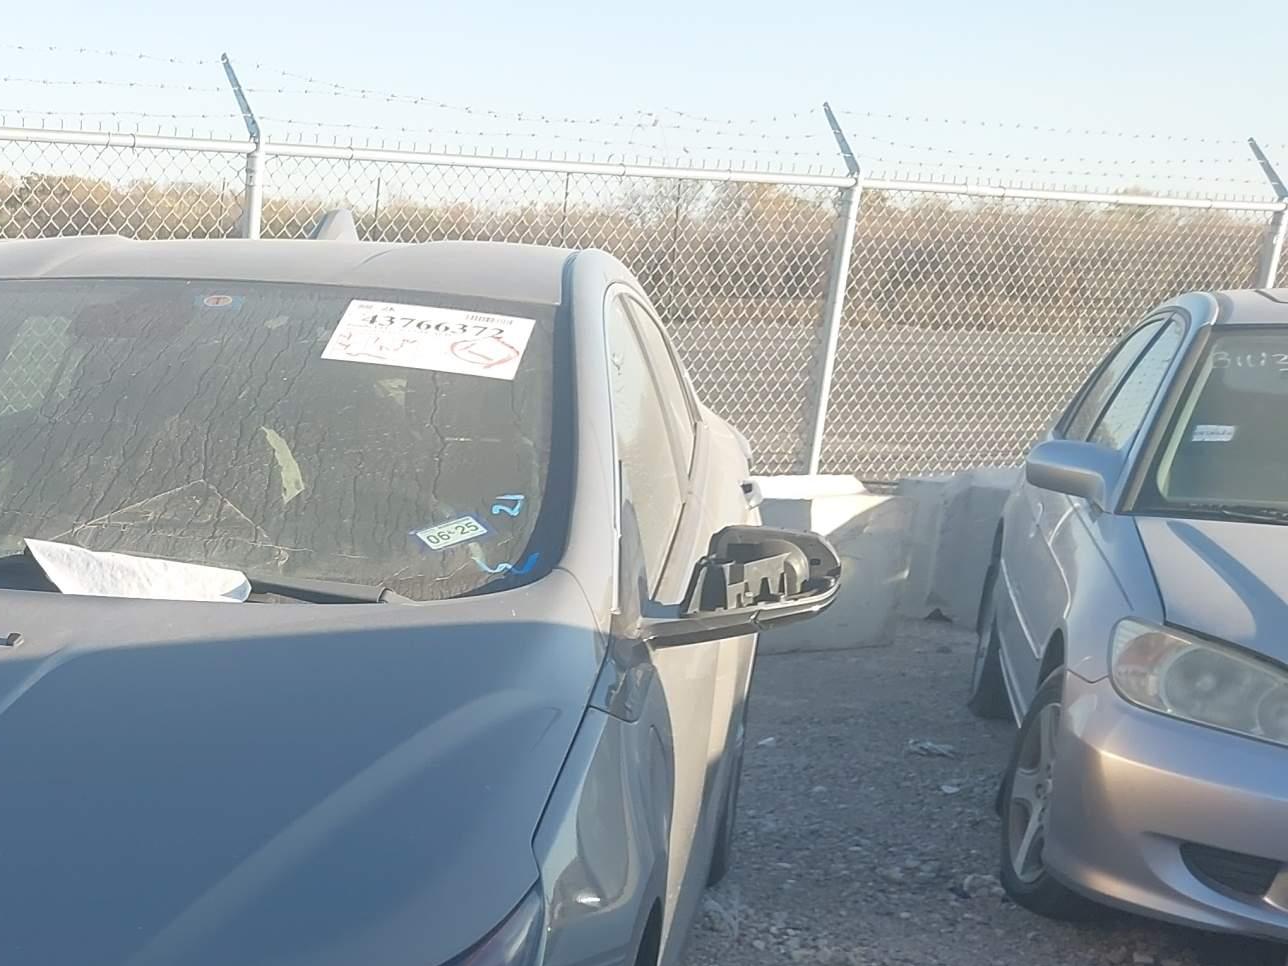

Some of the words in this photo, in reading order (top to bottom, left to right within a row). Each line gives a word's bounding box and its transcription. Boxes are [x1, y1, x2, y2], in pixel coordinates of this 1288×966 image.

[360, 313, 505, 339] 43766372
[426, 530, 451, 545] 06
[455, 521, 480, 536] 25
